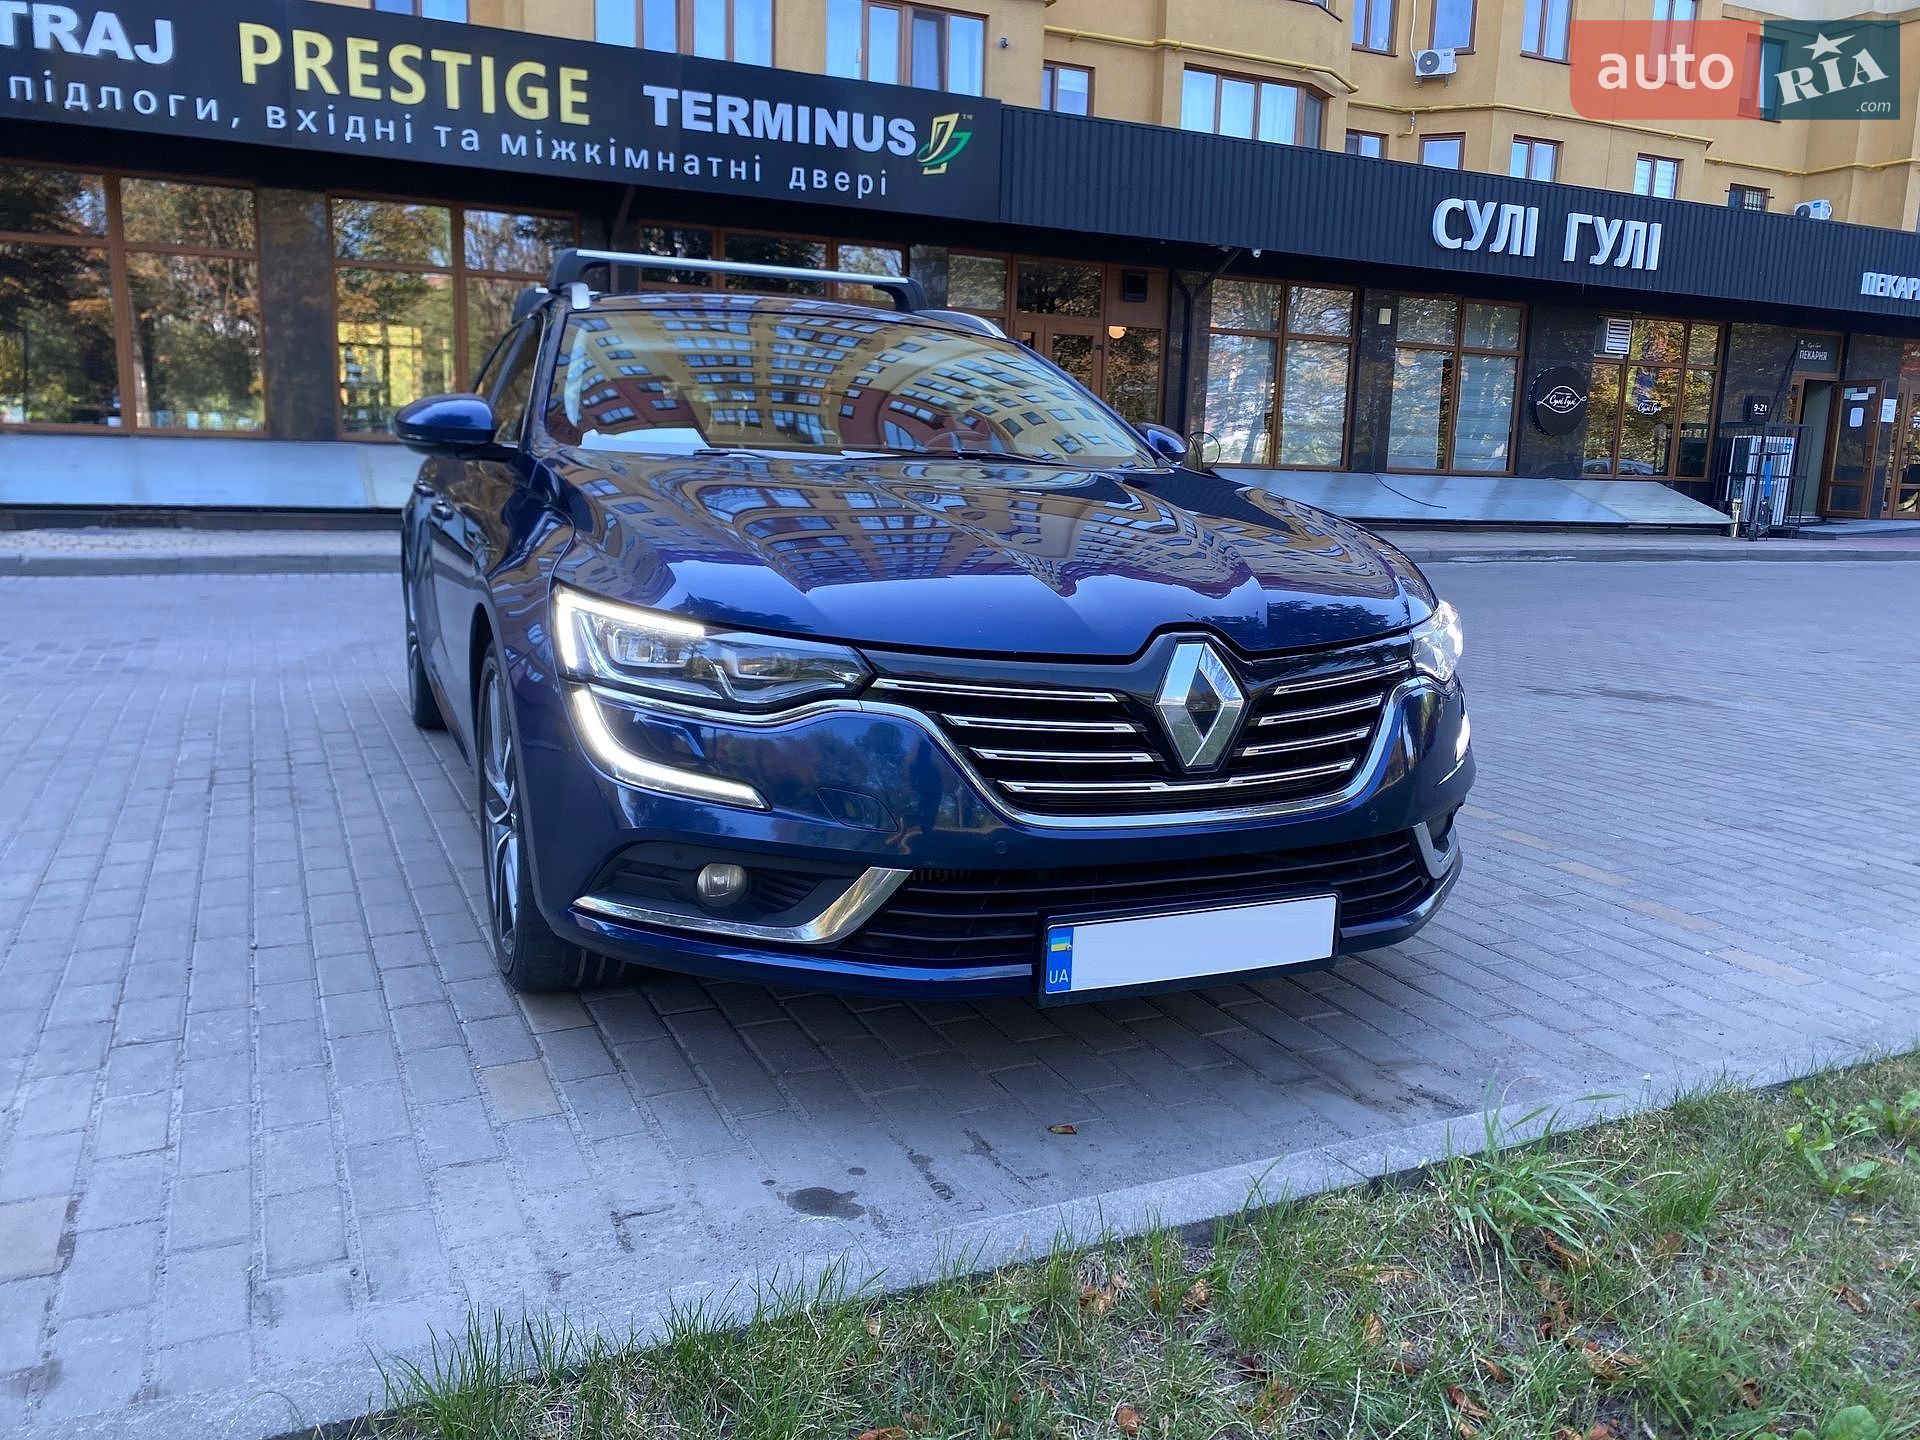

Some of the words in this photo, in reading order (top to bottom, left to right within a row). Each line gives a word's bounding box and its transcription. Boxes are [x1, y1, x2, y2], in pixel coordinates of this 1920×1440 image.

[0, 0, 173, 64] TRAJ
[238, 22, 591, 126] PRESTIGE
[9, 70, 240, 129] підлоги,
[266, 104, 414, 145] вхідні
[433, 124, 480, 153] та
[500, 130, 762, 183] міжкімнатні
[788, 166, 888, 199] двері
[642, 84, 917, 157] TERMINUS
[1432, 199, 1538, 258] СУЛІ
[1563, 212, 1662, 271] ГУЛІ
[1861, 272, 1920, 301] ПЕКАР
[1800, 350, 1827, 361] ПЕКАРНЯ
[1753, 403, 1767, 412] 9-21
[1049, 969, 1068, 984] UA
